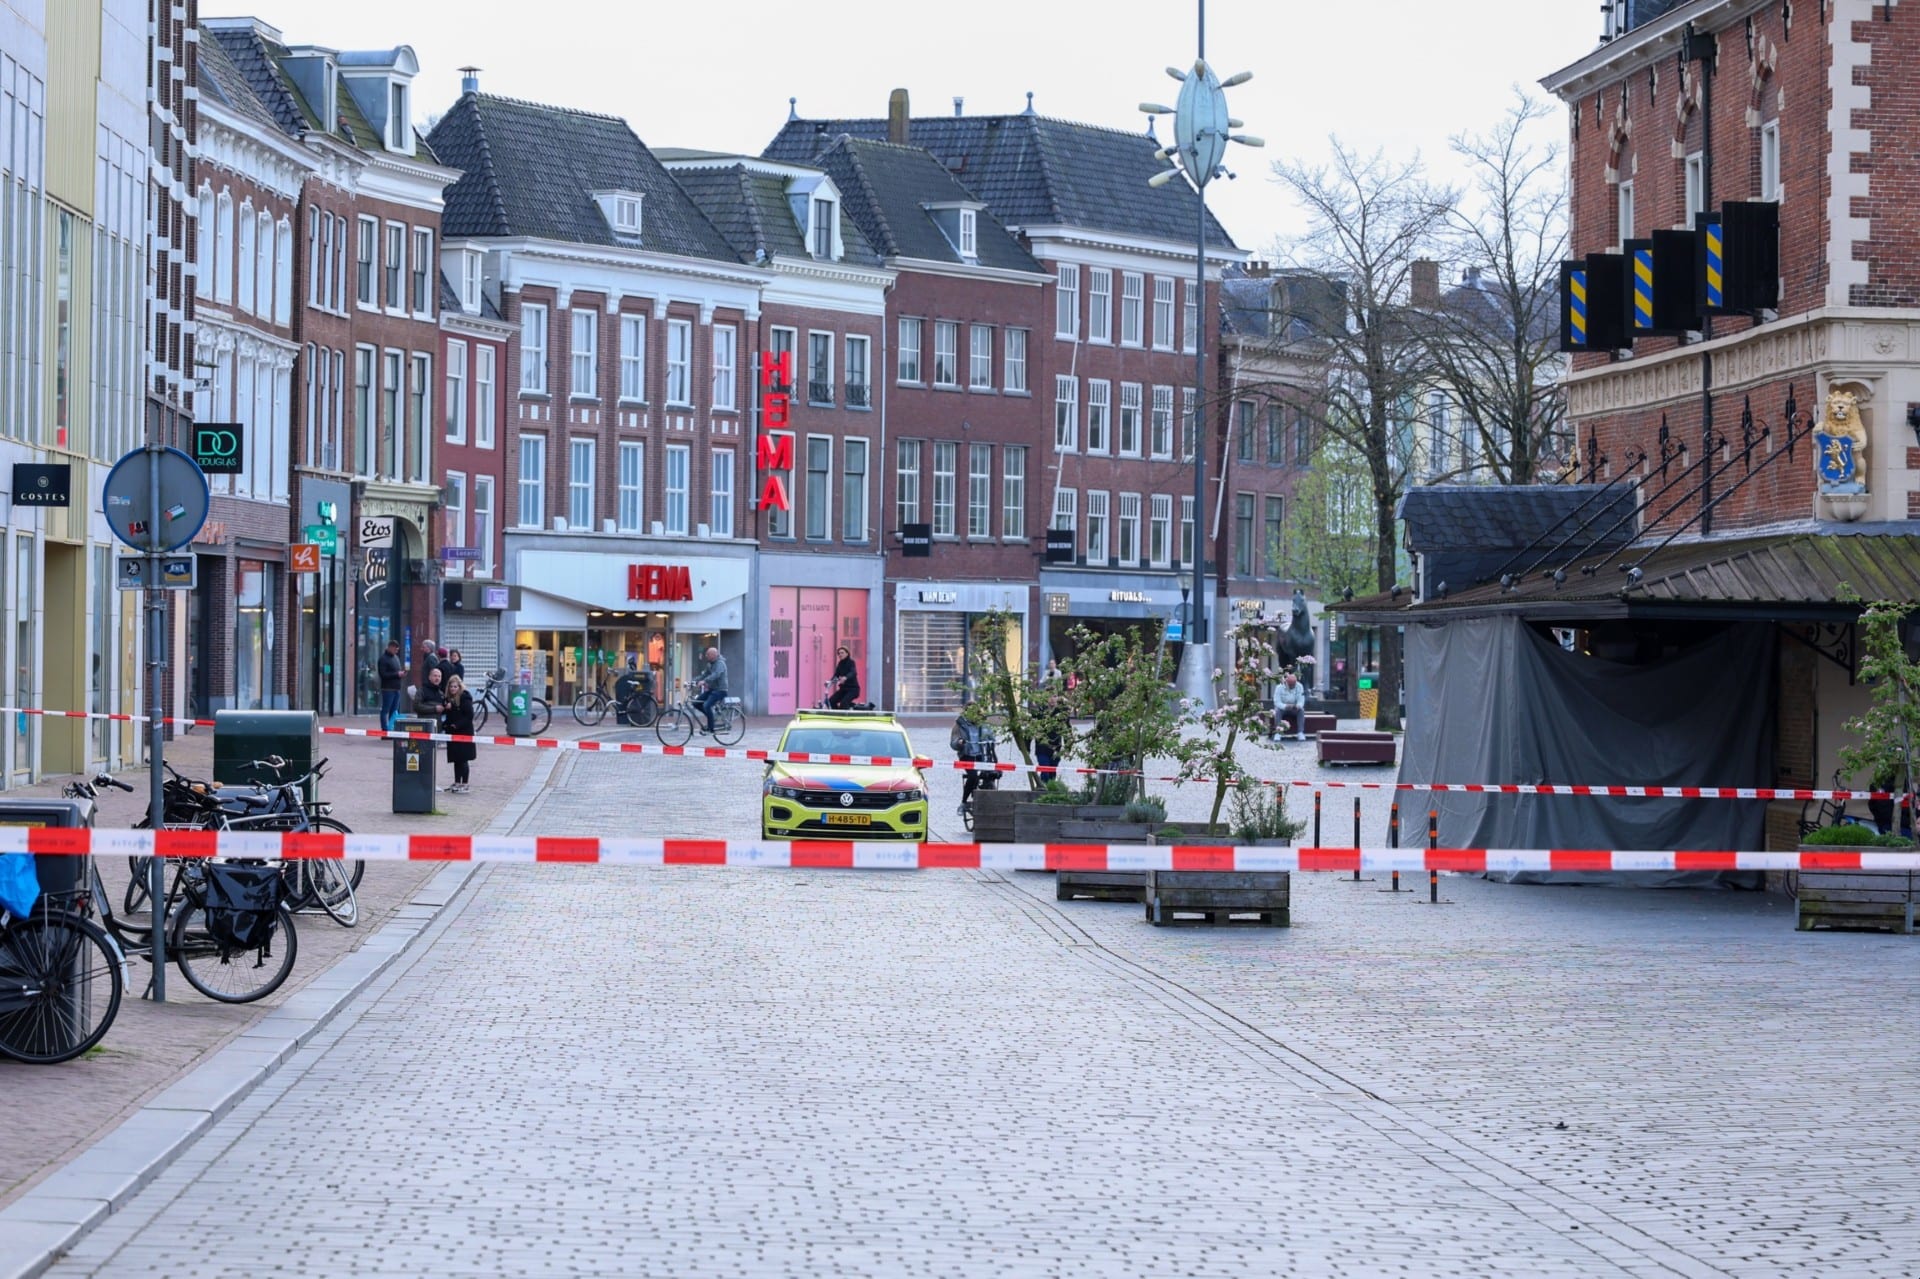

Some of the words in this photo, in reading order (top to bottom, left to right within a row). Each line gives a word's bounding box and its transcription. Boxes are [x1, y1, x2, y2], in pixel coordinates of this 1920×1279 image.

[757, 351, 793, 511] HEMA
[197, 457, 237, 467] DOUGLAS
[20, 492, 66, 501] COSTES
[362, 519, 391, 538] Etos
[627, 564, 693, 601] HEMA
